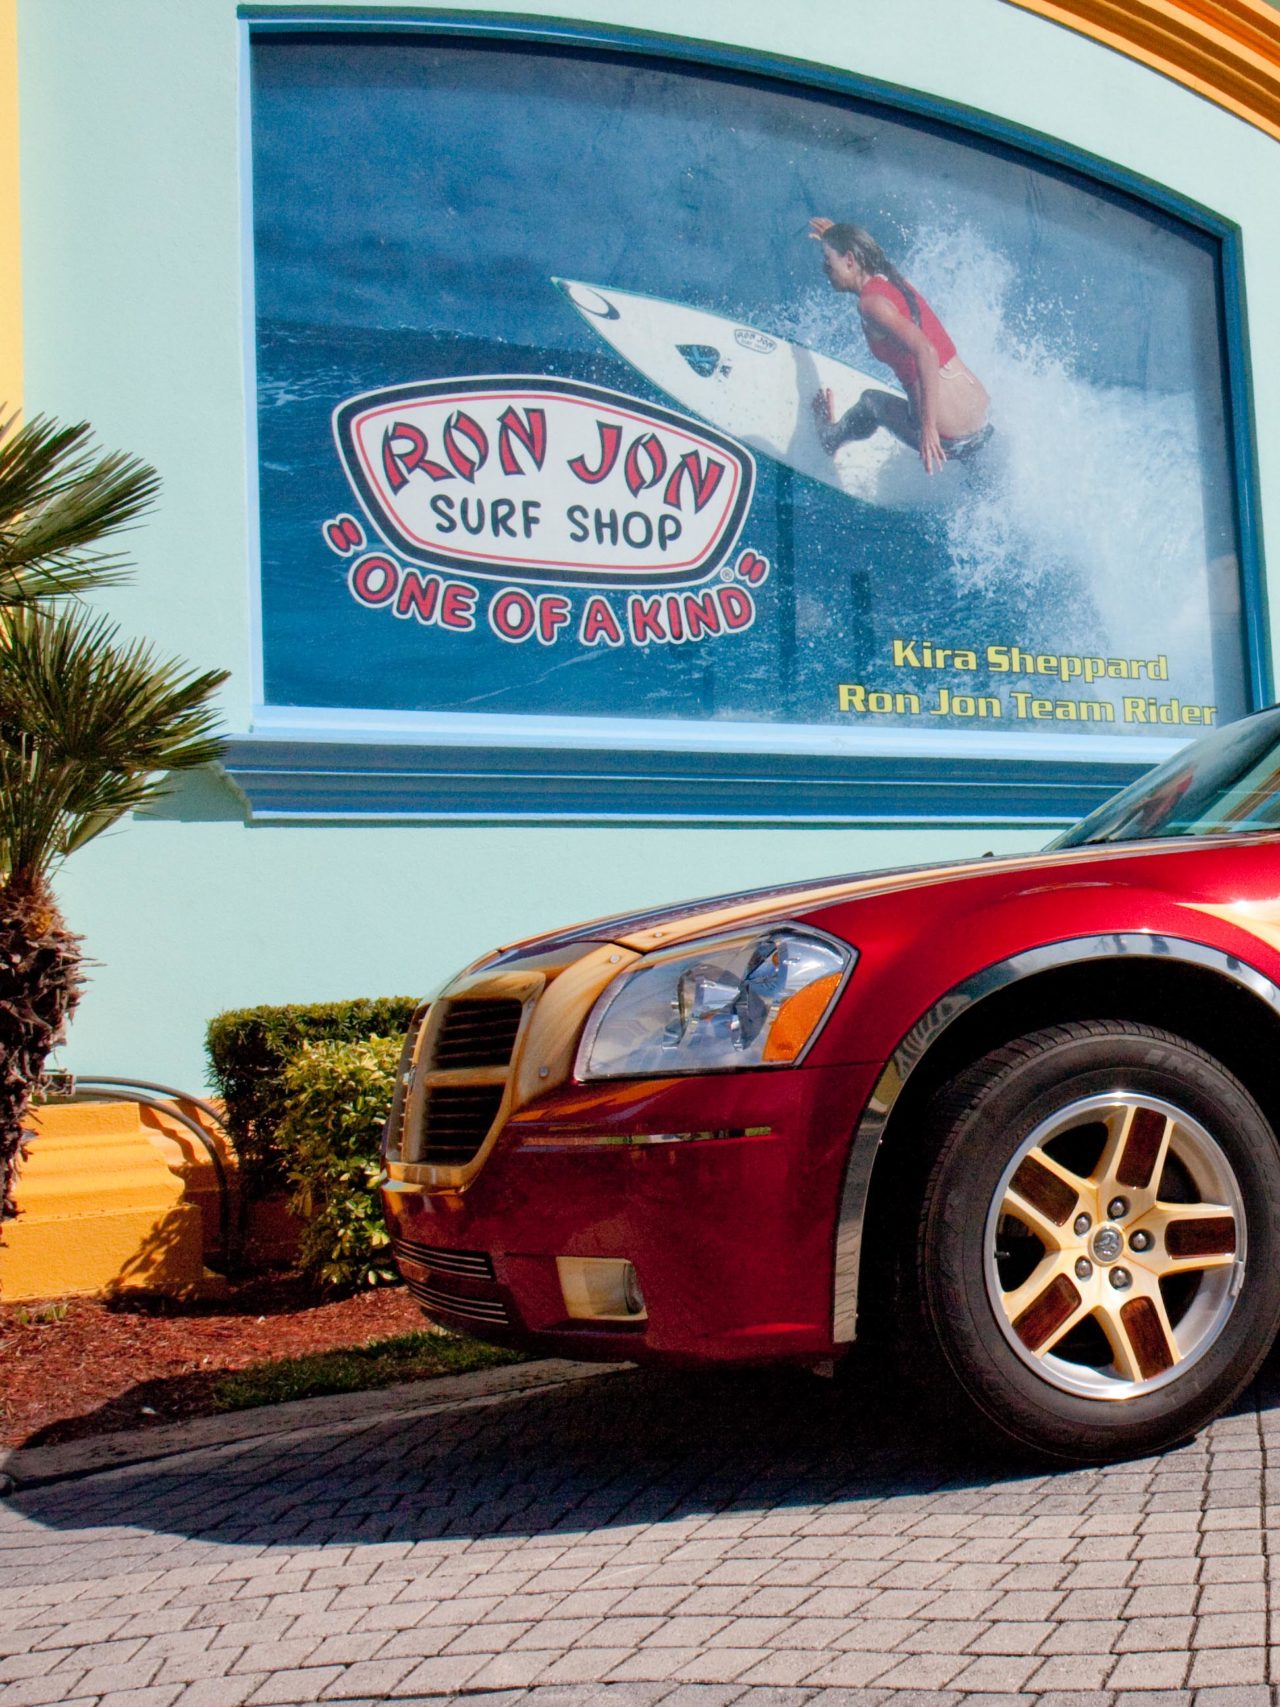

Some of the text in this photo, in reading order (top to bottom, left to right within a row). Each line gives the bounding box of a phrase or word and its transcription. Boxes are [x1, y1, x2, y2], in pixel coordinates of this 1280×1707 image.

[381, 405, 726, 514] RON JON
[430, 494, 682, 552] SURF SHOP
[491, 589, 570, 643] OF
[583, 597, 621, 643] A
[892, 639, 1169, 683] Kira Sheppard
[837, 683, 1218, 726] Ron Jon Team Rider
